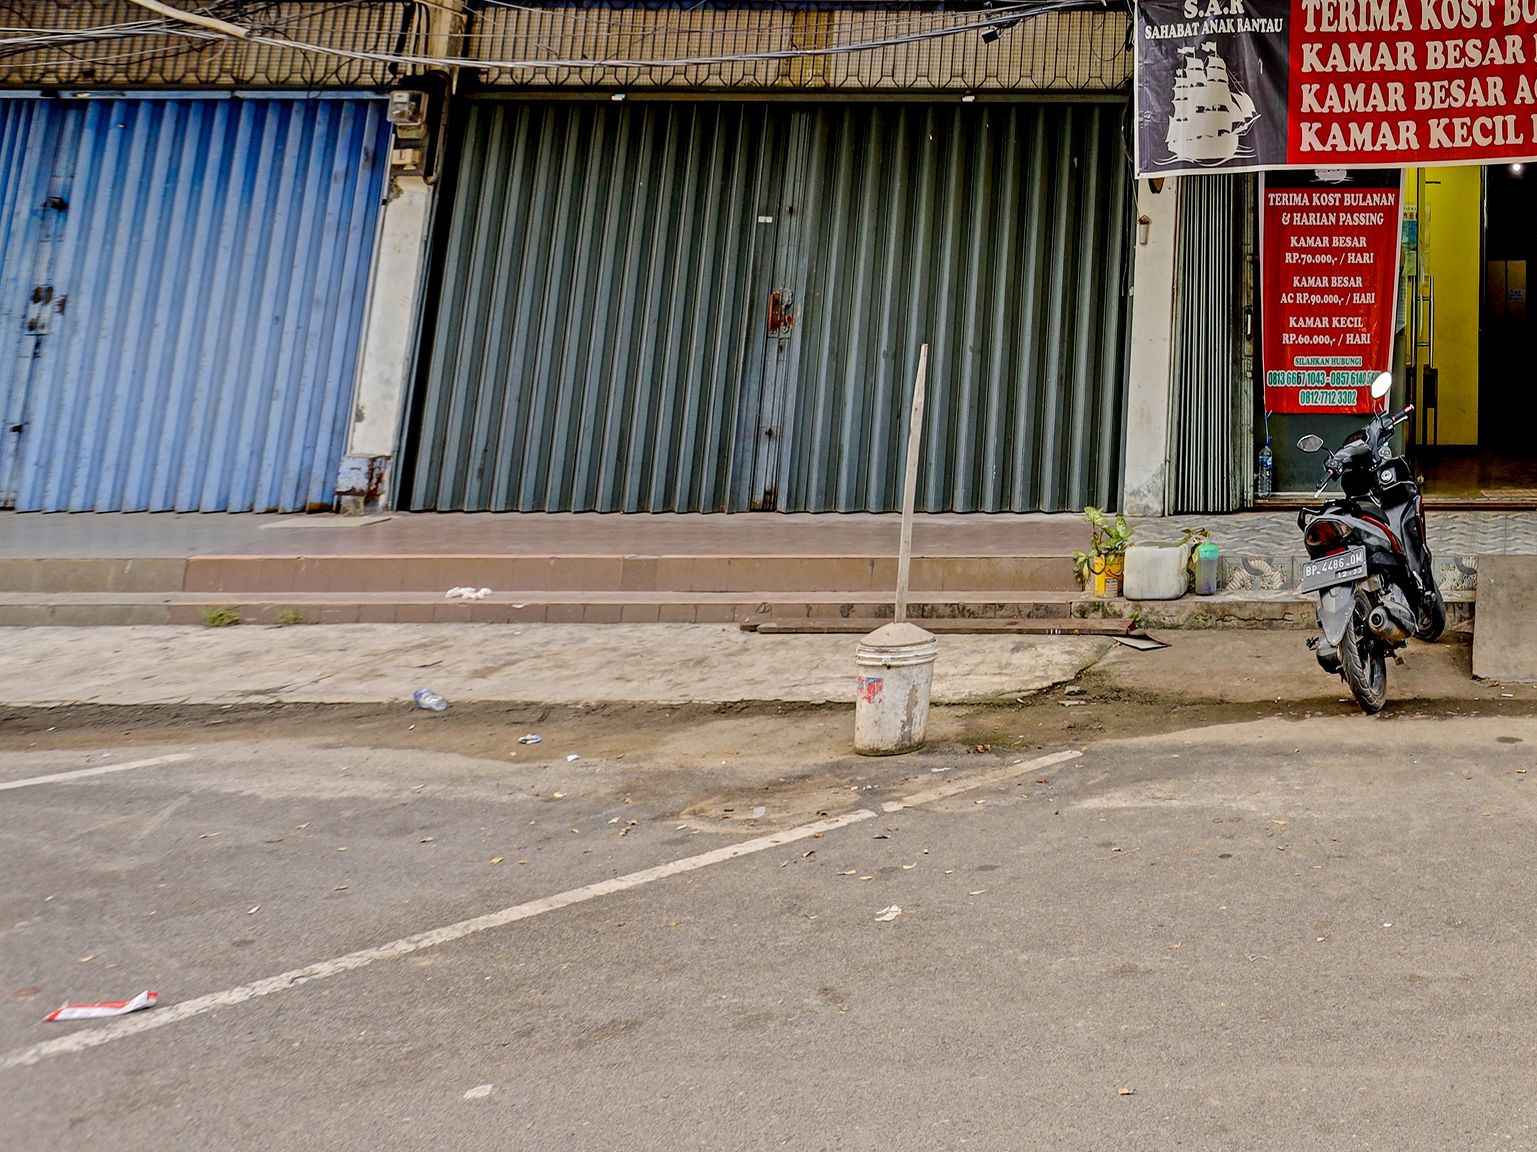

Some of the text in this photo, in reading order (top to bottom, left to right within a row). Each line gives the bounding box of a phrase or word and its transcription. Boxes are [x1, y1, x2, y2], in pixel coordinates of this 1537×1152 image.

[1144, 18, 1283, 40] SAHABAT ANAK RANTAU
[1301, 40, 1422, 73] KAMAR
[1425, 33, 1527, 72] BESAR
[1300, 81, 1407, 114] KAMAR
[1414, 76, 1507, 112] BESAR
[1300, 119, 1419, 153] KAMAR
[1428, 113, 1523, 150] KECIL
[1268, 193, 1395, 206] TERIMA KOST BULANAN
[1281, 213, 1384, 226] & HARIAN PASSING
[1290, 236, 1367, 247] KAMAR BESAR
[1285, 252, 1338, 265] RP.70.000,-
[1347, 252, 1374, 264] HARI
[1293, 276, 1363, 288] KAMAR BESAR
[1280, 293, 1294, 304] AC
[1296, 293, 1344, 306] RP.90.000,-
[1352, 293, 1376, 304] HARI
[1289, 316, 1364, 328] KAMAR KECIL
[1282, 334, 1336, 346] RP.60.000,-
[1346, 334, 1371, 345] HARI
[1294, 356, 1362, 366] SILAHKAN HUBUNGI
[1267, 371, 1285, 386] 0813
[1286, 371, 1306, 386] 6667
[1306, 371, 1326, 386] 1043
[1330, 371, 1350, 386] 0857
[1300, 390, 1357, 405] 0812 7712 3302
[1306, 565, 1317, 576] BP
[1322, 558, 1344, 572] 4486
